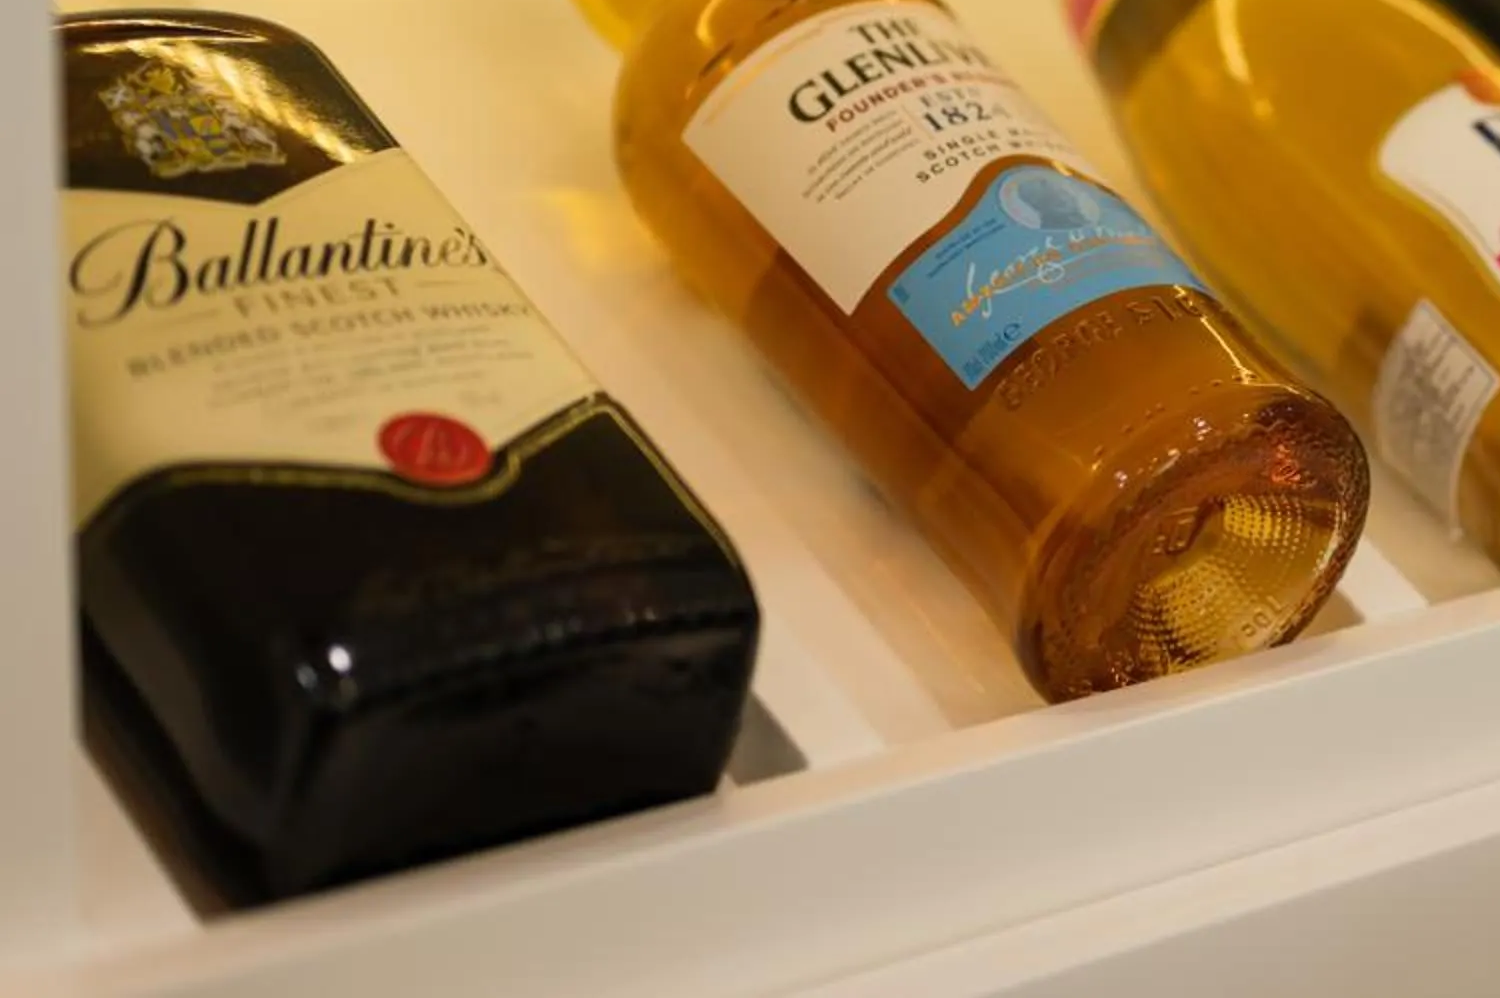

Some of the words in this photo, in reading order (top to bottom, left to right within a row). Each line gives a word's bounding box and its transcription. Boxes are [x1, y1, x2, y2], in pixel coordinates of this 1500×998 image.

[825, 71, 948, 133] FOUNDER'S
[914, 143, 1003, 184] SCOTCH
[922, 126, 1001, 162] SINGLE
[68, 216, 490, 330] Ballantine's
[233, 276, 401, 320] FINEST
[288, 306, 416, 339] SCOTCH
